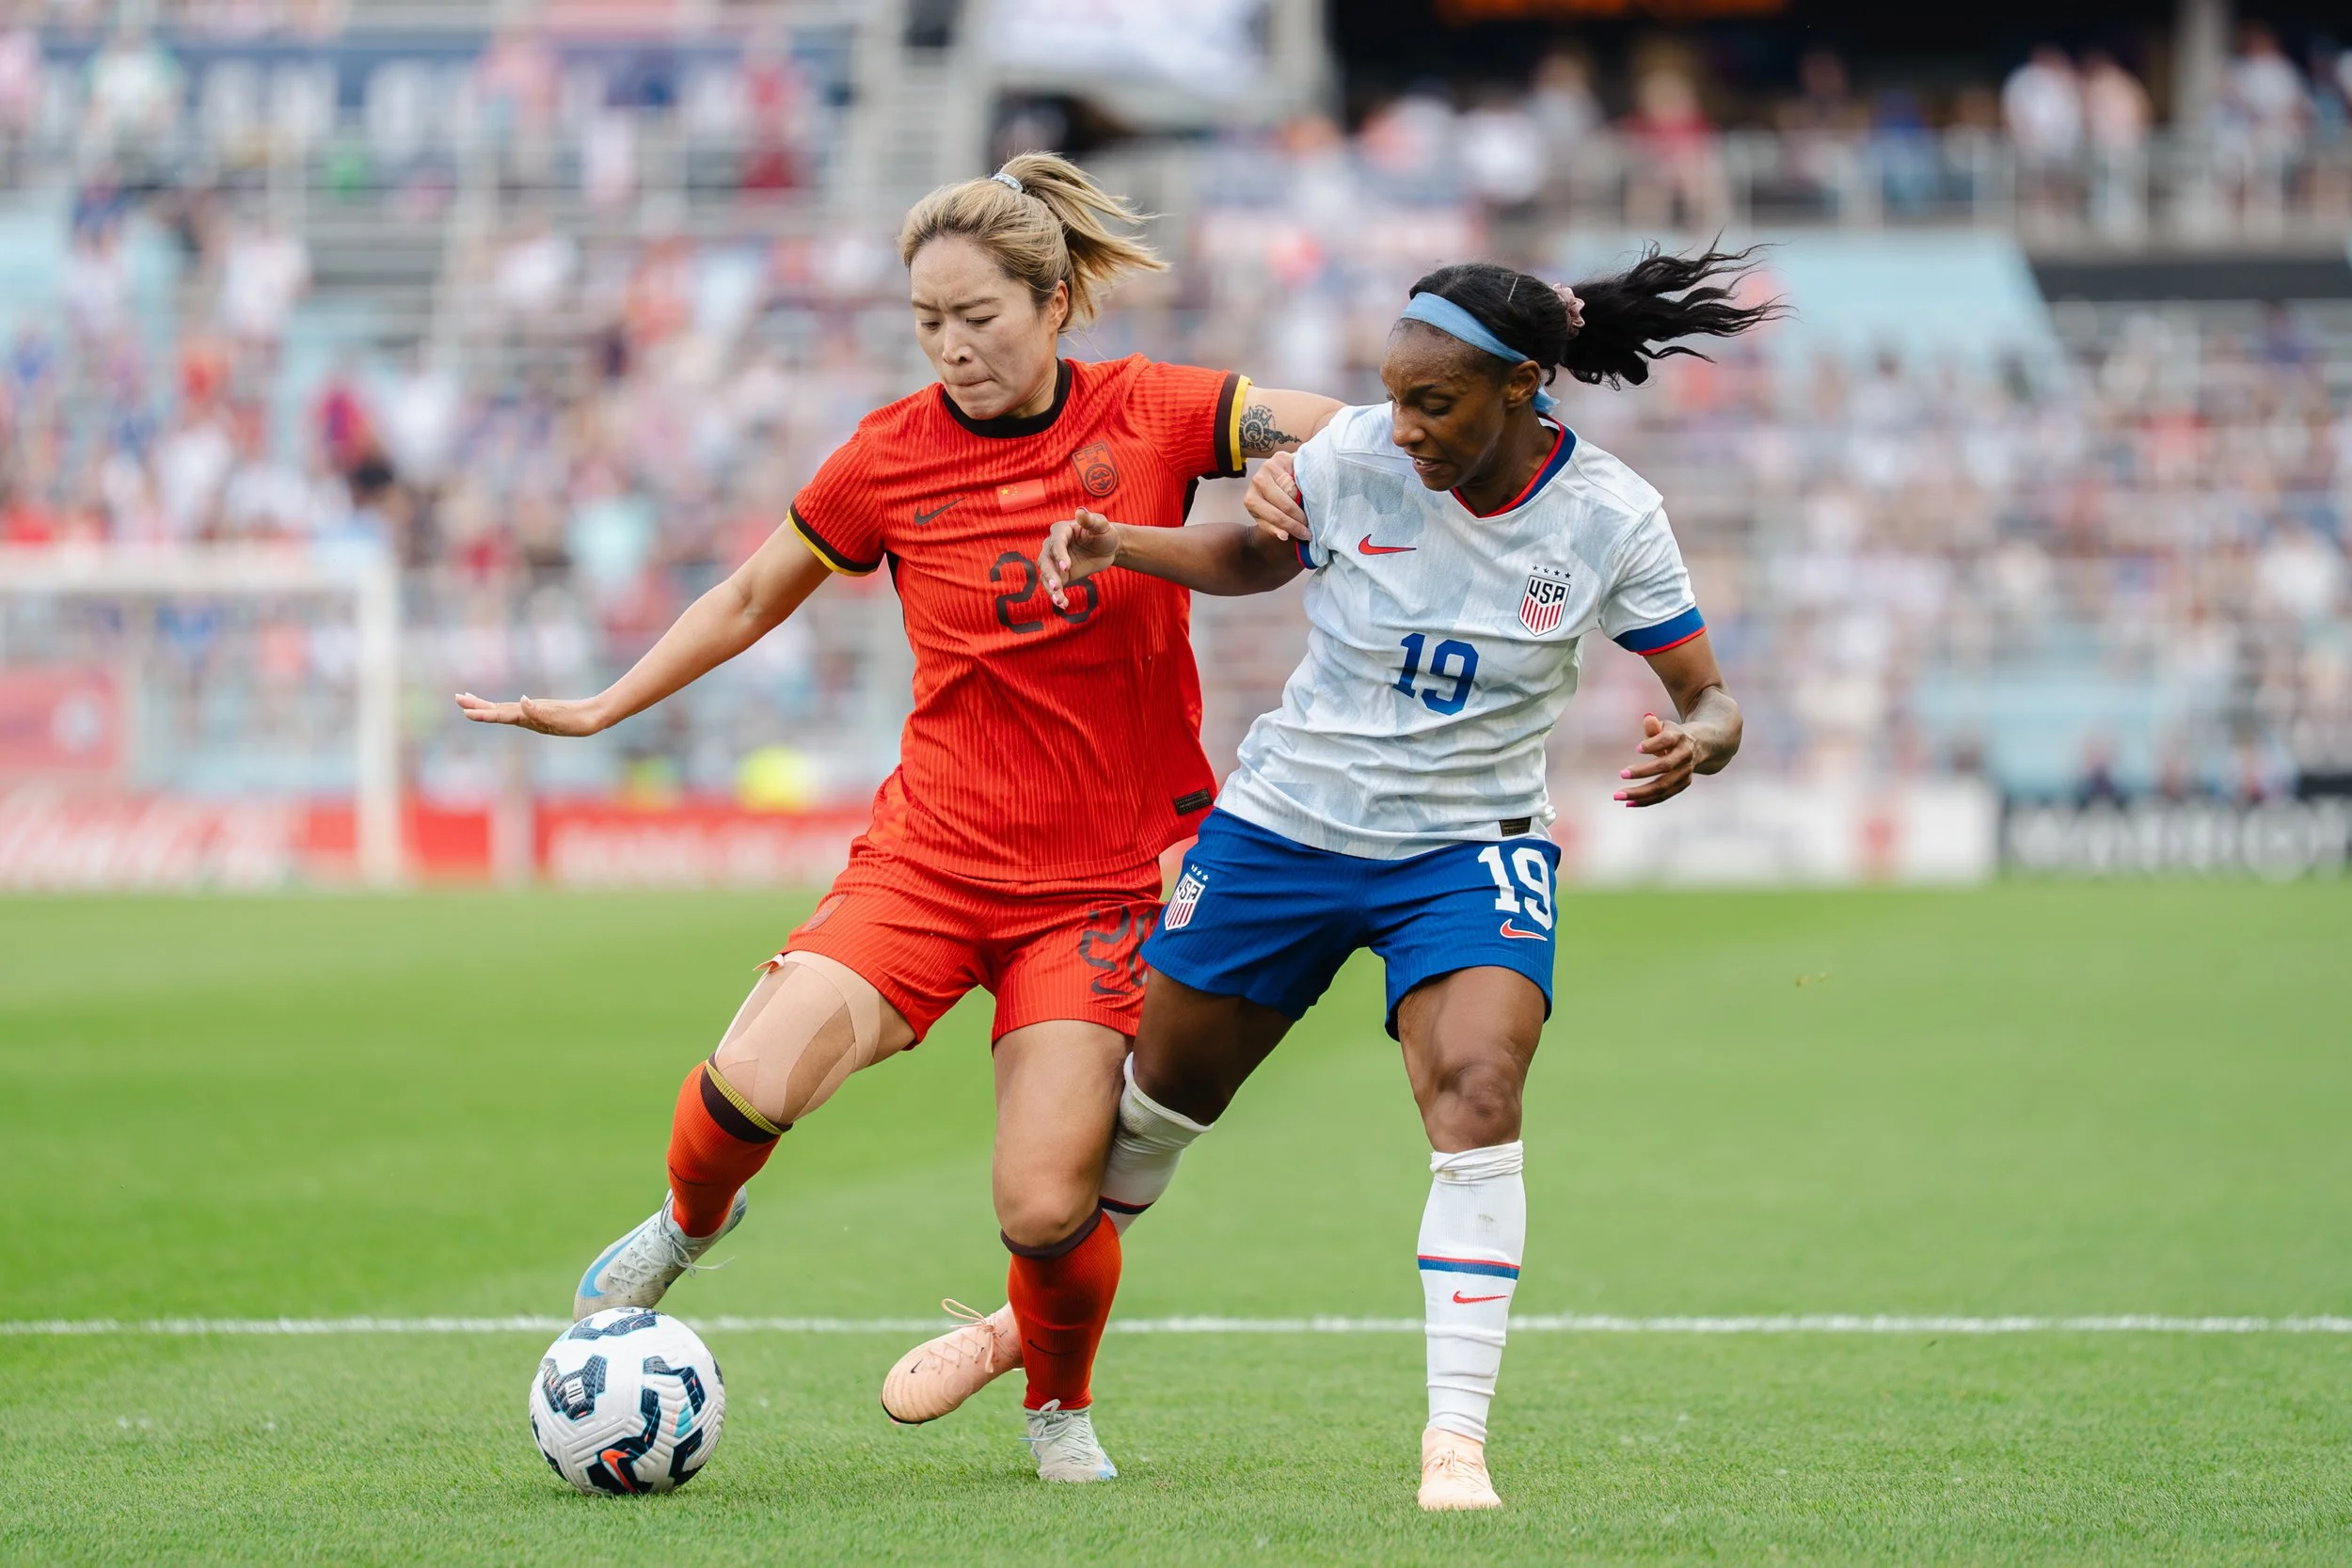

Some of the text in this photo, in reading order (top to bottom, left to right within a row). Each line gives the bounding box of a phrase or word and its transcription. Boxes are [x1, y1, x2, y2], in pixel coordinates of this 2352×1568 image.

[1528, 579, 1566, 604] USA
[1392, 632, 1479, 716] 19
[1477, 846, 1552, 930] 19
